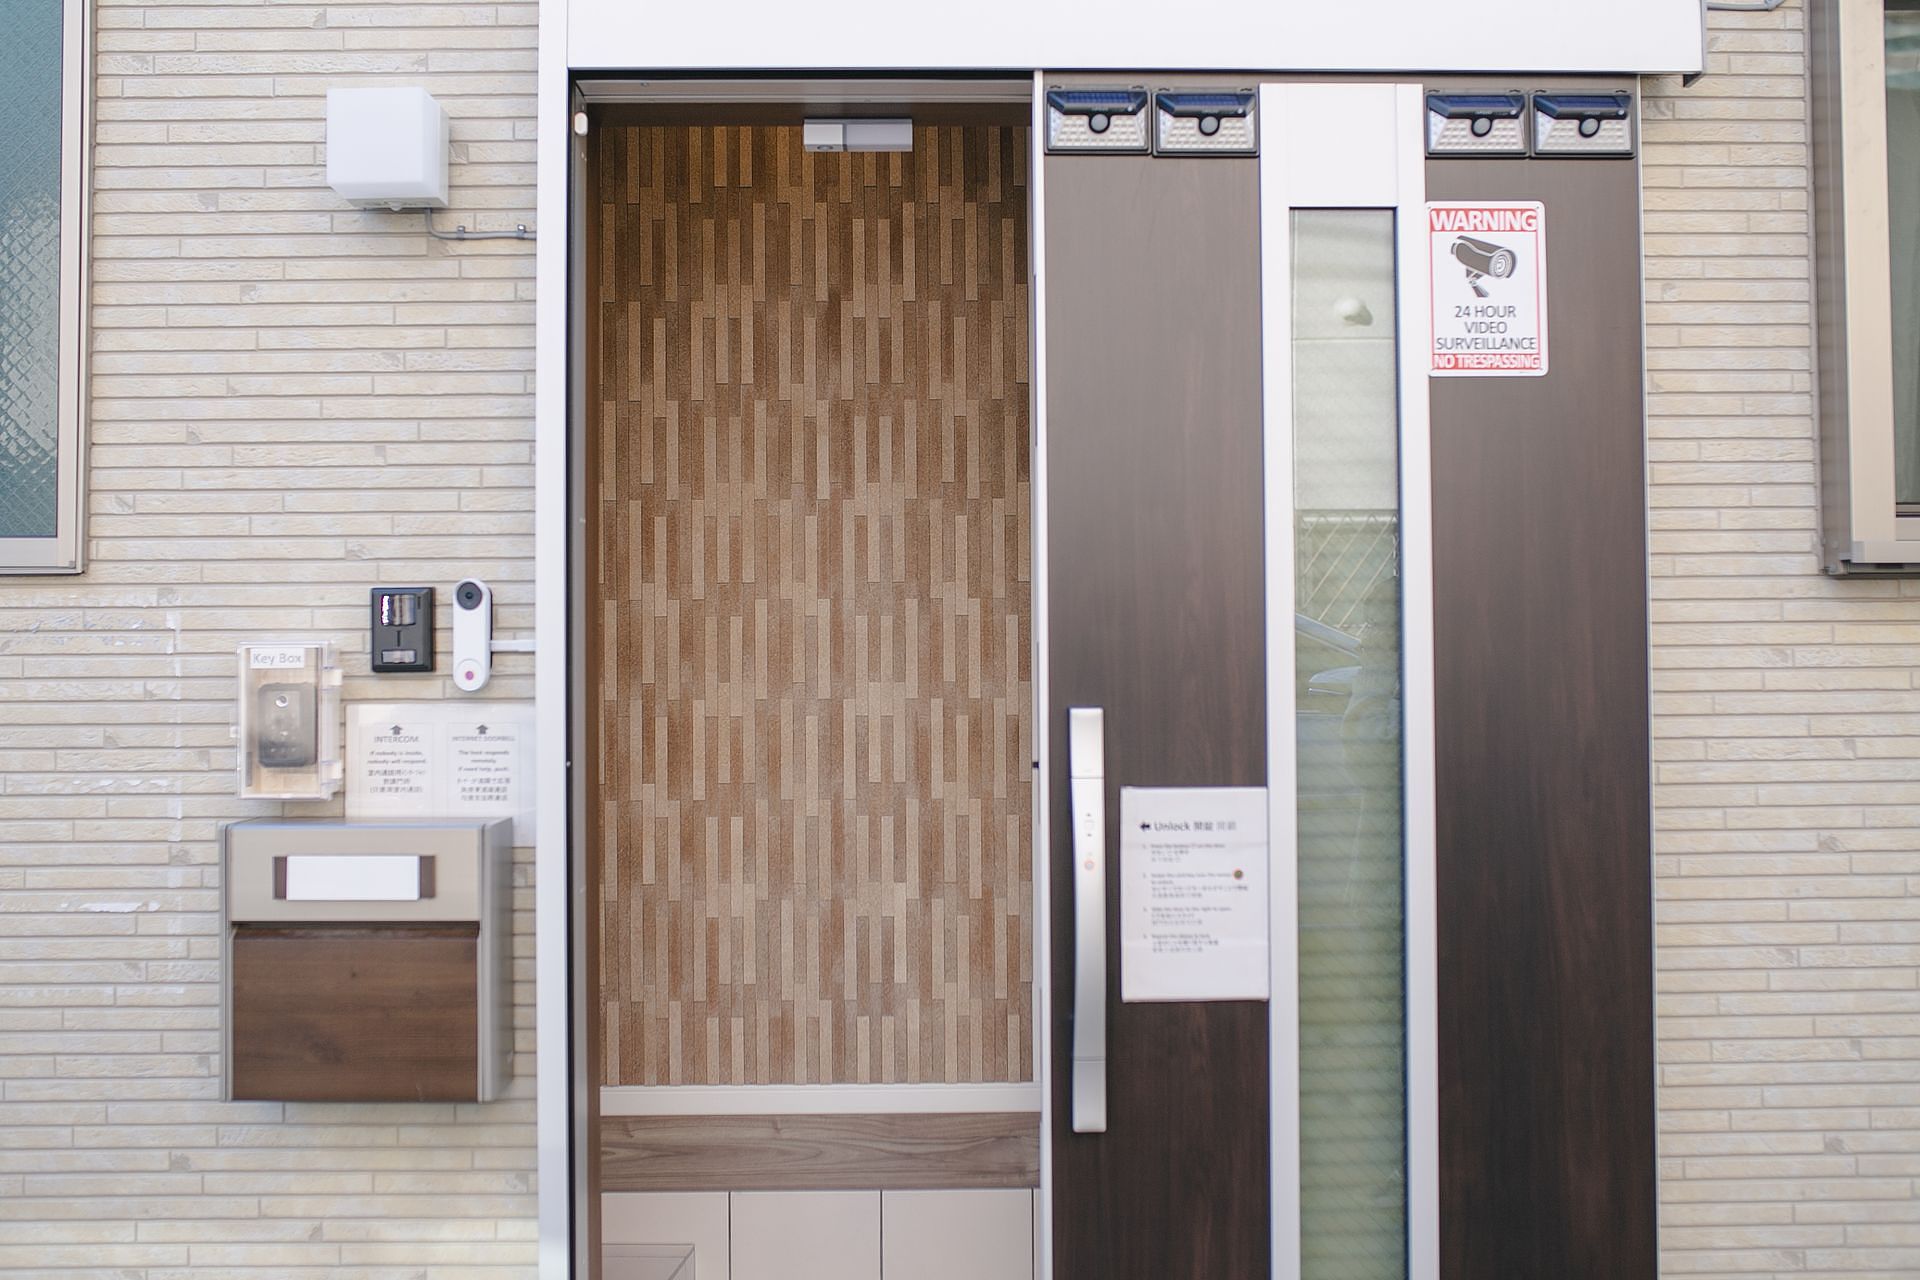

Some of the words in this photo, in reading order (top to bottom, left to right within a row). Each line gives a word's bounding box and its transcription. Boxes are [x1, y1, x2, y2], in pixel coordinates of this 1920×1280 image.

[1431, 210, 1538, 231] WARNING
[1454, 305, 1471, 318] 24
[1474, 305, 1517, 318] HOUR
[1464, 321, 1508, 334] VIDEO
[1436, 337, 1537, 350] SURVEILLANCE
[1434, 355, 1456, 369] NO
[1457, 354, 1541, 369] TRESPASSING
[252, 653, 276, 667] Key
[278, 652, 302, 665] Box
[374, 735, 419, 743] INTERCOM
[1154, 820, 1190, 832] Unlock
